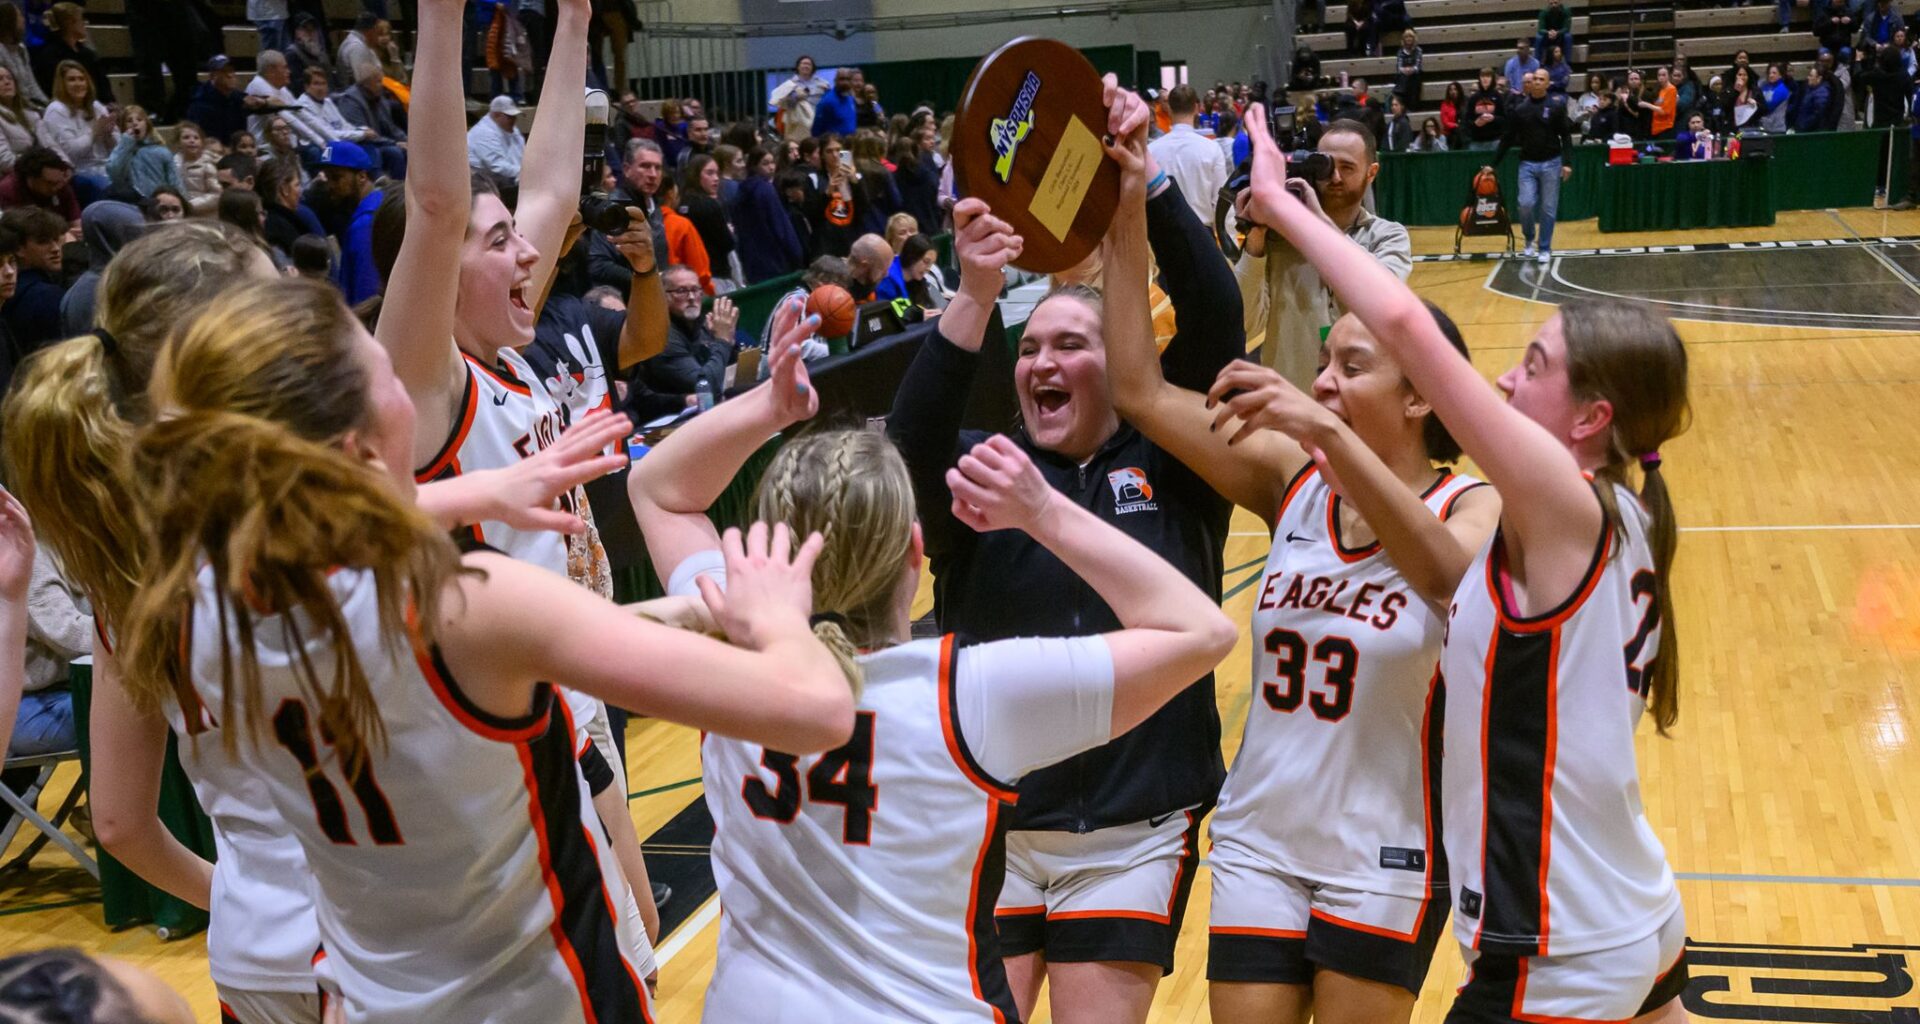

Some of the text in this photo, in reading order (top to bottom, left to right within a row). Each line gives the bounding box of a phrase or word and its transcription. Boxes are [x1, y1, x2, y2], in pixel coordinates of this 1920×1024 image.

[996, 71, 1040, 159] NYSPHSAA
[1115, 502, 1158, 515] BASKETBALL
[1258, 571, 1408, 631] EAGLES
[1623, 567, 1662, 700] 2
[1262, 626, 1360, 724] 33
[273, 697, 406, 846] 11
[741, 710, 879, 847] 34
